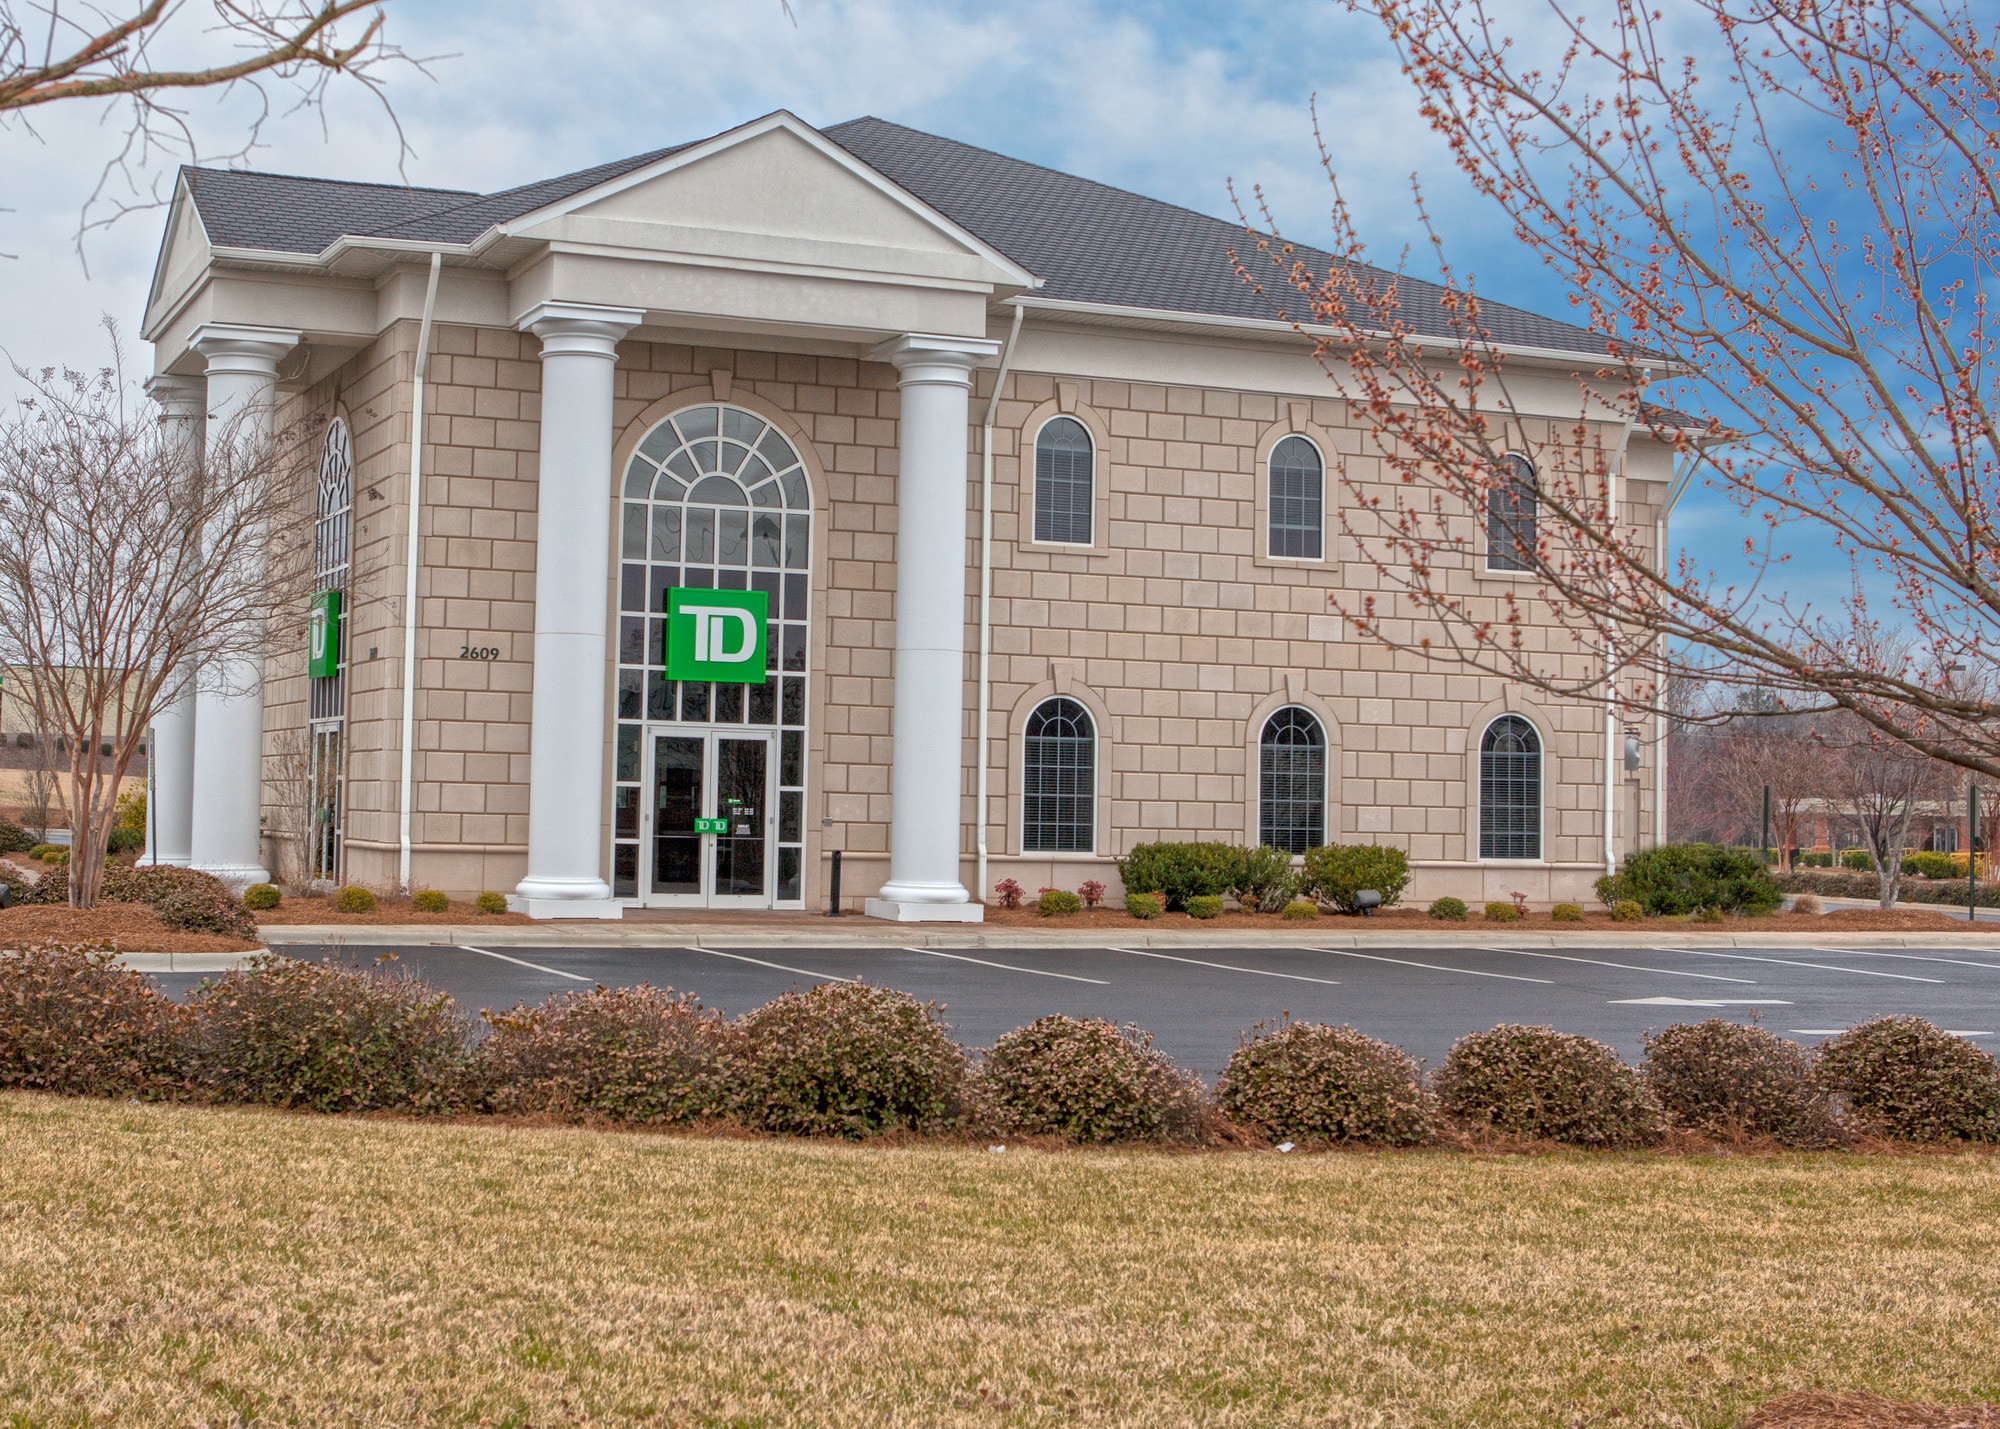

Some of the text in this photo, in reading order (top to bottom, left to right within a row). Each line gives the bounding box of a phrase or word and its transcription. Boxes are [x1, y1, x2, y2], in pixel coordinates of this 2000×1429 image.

[679, 605, 757, 663] TD
[460, 646, 499, 660] 2609
[697, 821, 709, 830] TD
[713, 821, 725, 831] TD
